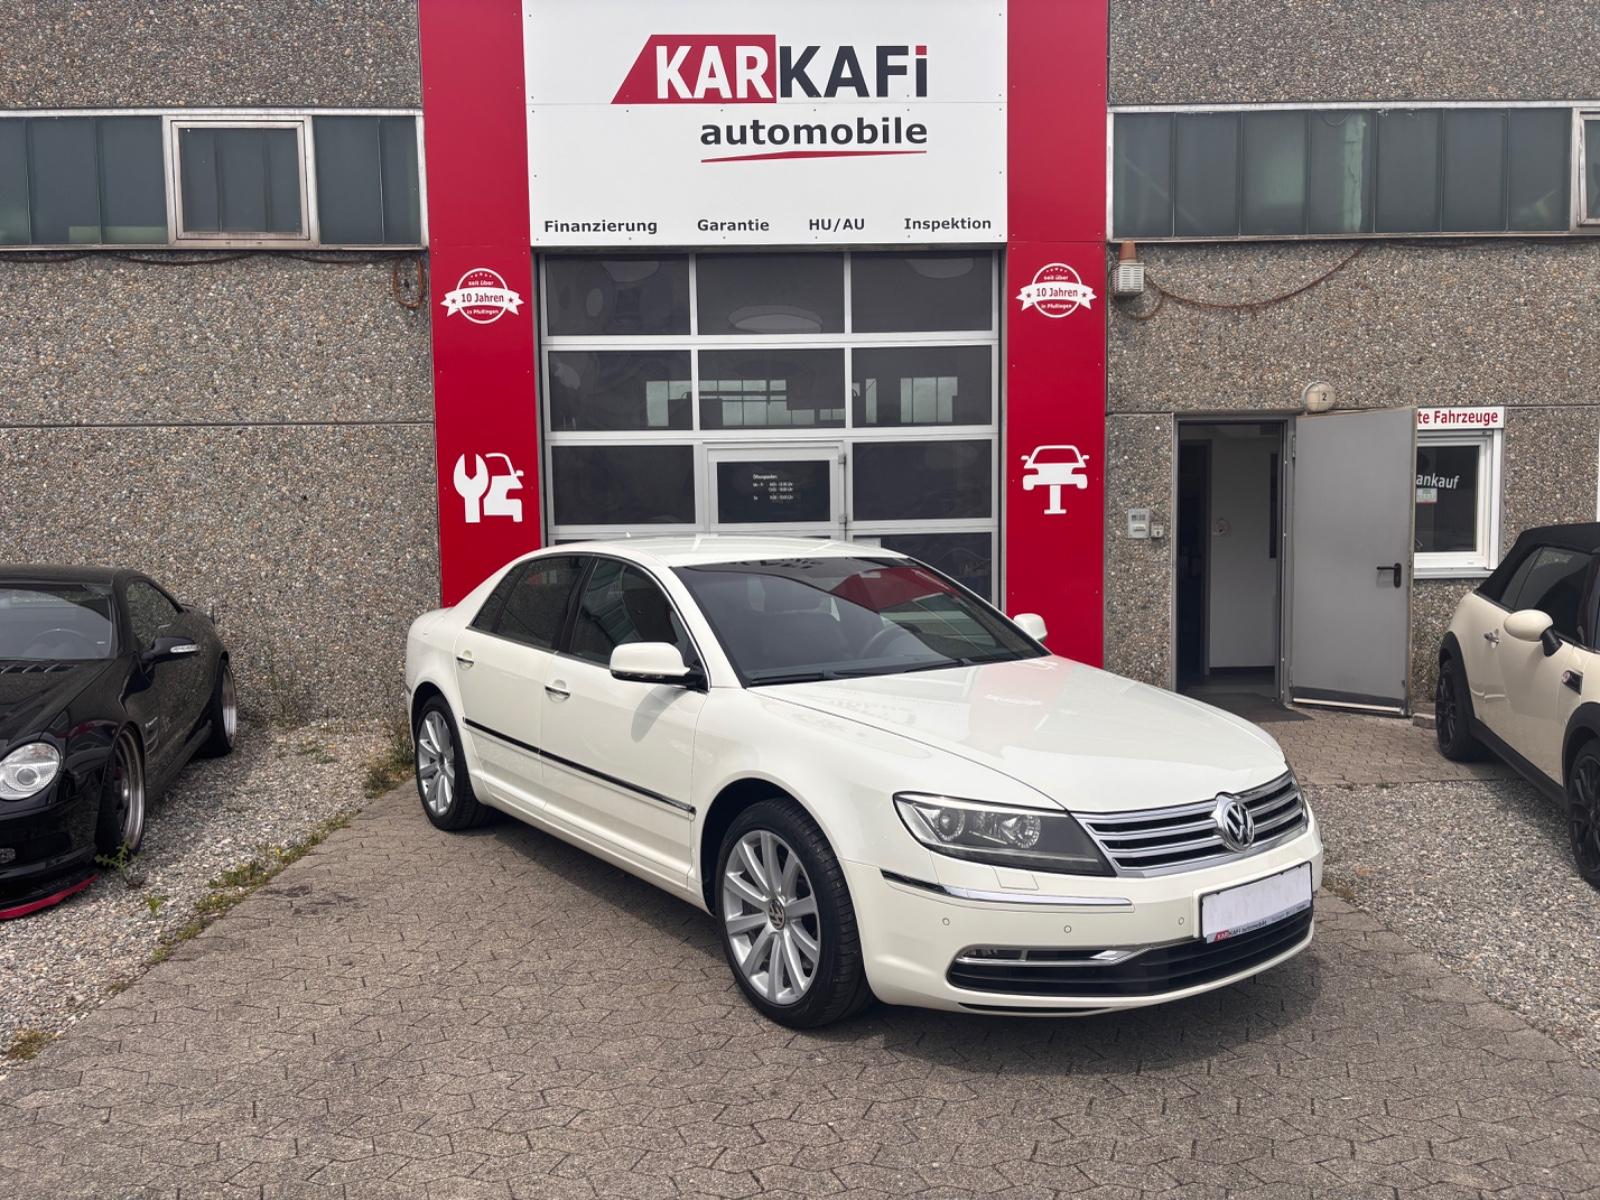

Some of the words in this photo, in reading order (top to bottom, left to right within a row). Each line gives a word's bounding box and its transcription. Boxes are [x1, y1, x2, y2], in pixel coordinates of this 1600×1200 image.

[700, 117, 928, 145] automobile
[544, 220, 658, 235] Finanzierung
[697, 219, 770, 232] Garantie
[809, 218, 865, 233] HU/AU
[904, 217, 992, 232] Inspektion
[461, 293, 472, 303] 10
[474, 293, 504, 303] Jahren
[1036, 287, 1047, 297] 10
[1048, 287, 1078, 297] Jahren
[1321, 391, 1328, 401] 2
[1434, 410, 1498, 426] Fahrzeuge
[1416, 473, 1460, 489] ankauf
